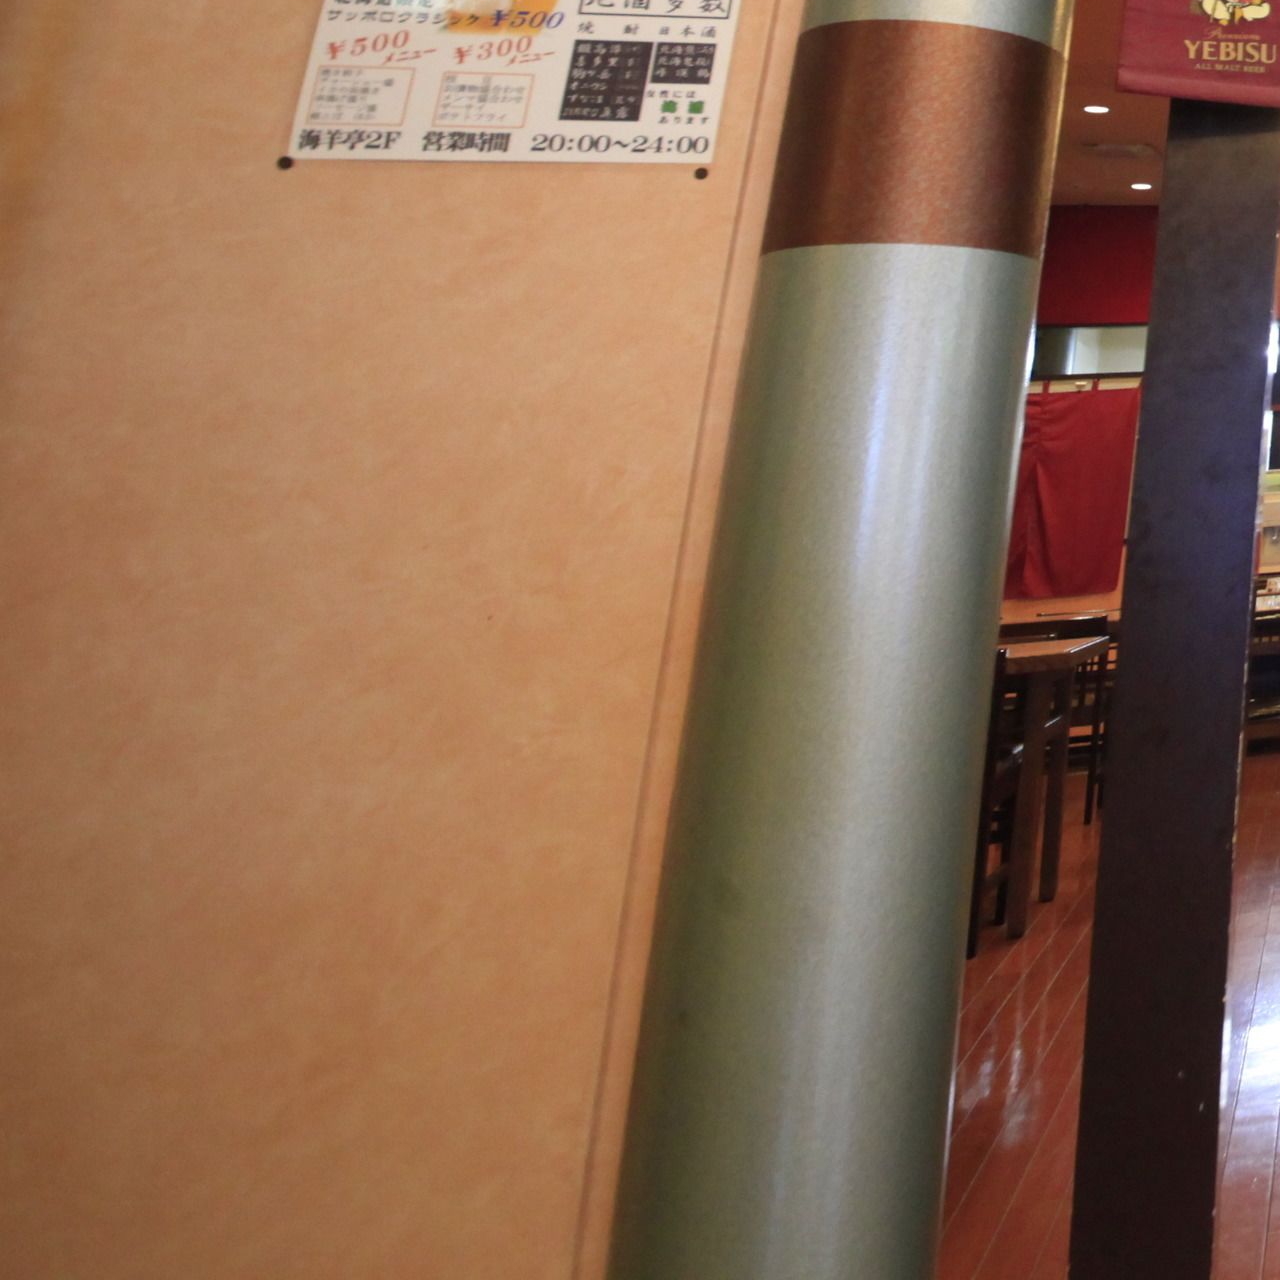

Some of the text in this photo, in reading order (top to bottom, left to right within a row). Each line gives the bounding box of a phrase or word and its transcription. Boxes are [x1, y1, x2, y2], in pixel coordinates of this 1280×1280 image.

[491, 9, 565, 30] ¥500
[658, 23, 718, 39] 日本酒
[326, 30, 411, 60] ¥500
[453, 36, 534, 65] ¥300
[1183, 38, 1277, 65] YEBISU
[421, 130, 512, 152] 営業時間
